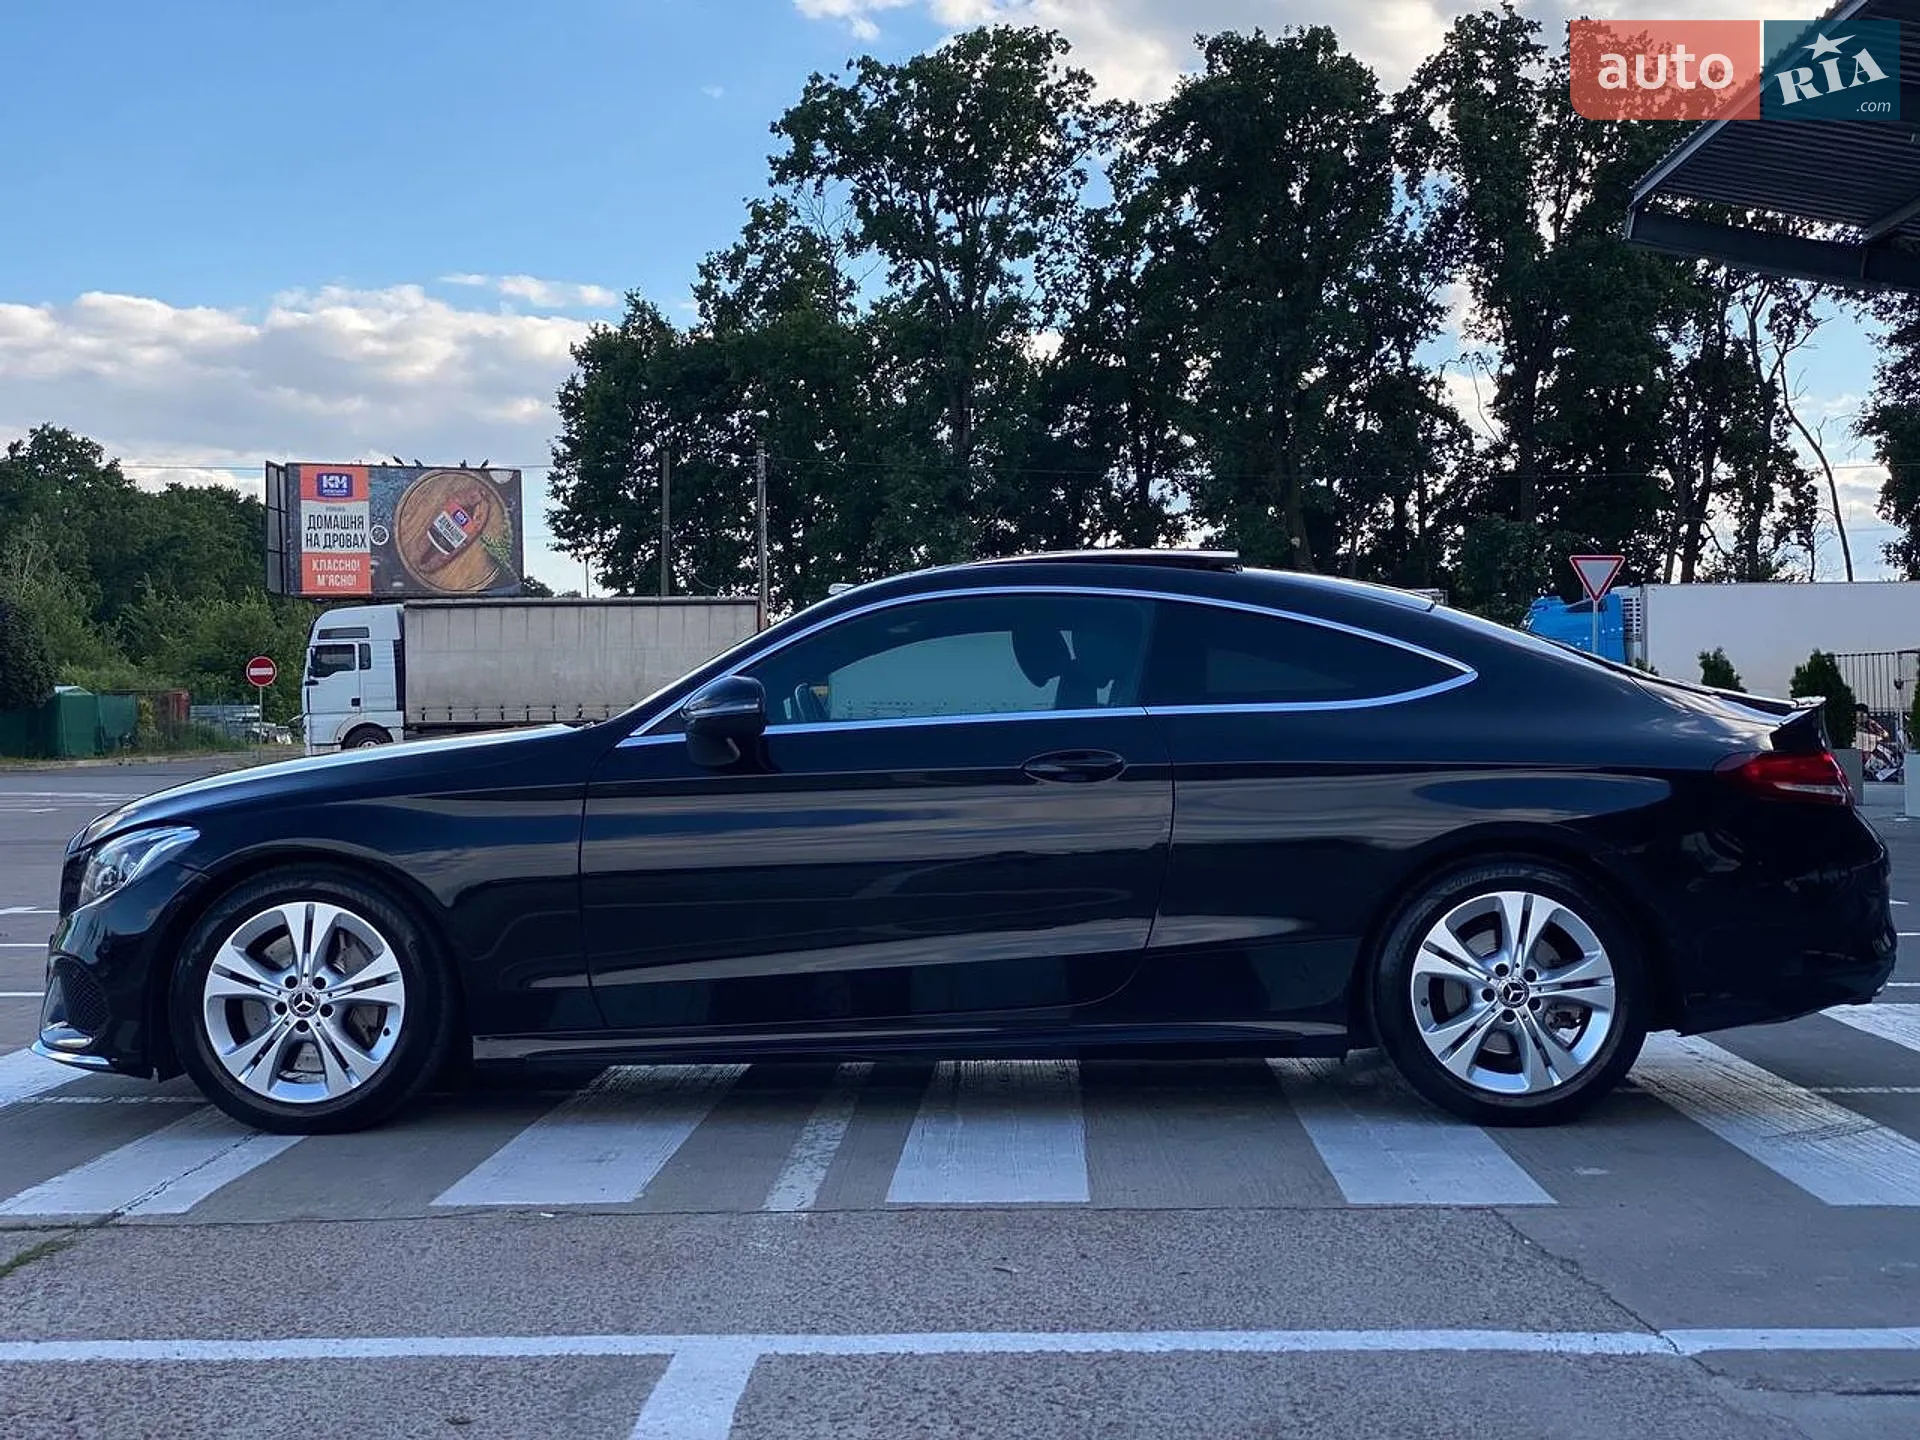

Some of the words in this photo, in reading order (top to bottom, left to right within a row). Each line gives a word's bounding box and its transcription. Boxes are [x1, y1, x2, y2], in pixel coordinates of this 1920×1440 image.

[307, 514, 364, 531] ДОМАШНЯ
[306, 533, 321, 548] НА
[323, 533, 367, 549] ДРОВАХ
